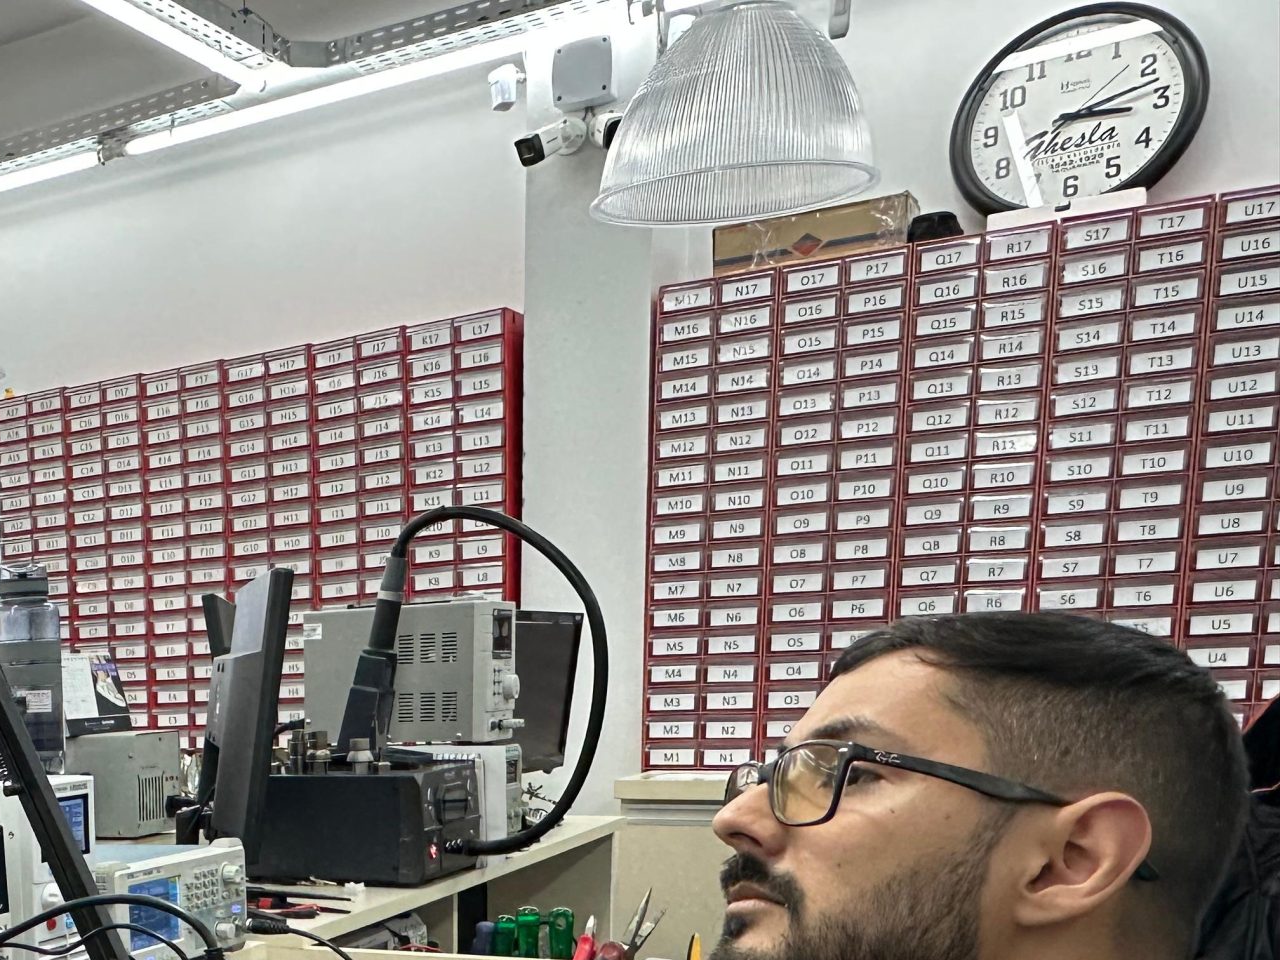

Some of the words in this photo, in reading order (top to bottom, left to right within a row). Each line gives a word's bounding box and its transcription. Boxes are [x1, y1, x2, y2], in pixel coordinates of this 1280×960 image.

[1141, 54, 1157, 78] 2
[1000, 86, 1027, 111] 10
[1153, 85, 1171, 110] 3
[983, 126, 999, 148] 9
[1135, 127, 1152, 148] 4
[995, 158, 1010, 180] 8
[1105, 156, 1121, 179] 5
[1063, 175, 1079, 197] 6
[1245, 202, 1276, 216] U17
[1158, 215, 1185, 229] T17
[1084, 227, 1110, 241] S17
[1241, 237, 1270, 252] U16
[936, 251, 961, 265] Q17
[1158, 250, 1184, 264] T16
[866, 262, 888, 276] P17
[1082, 262, 1106, 276] S16
[801, 273, 824, 286] O17
[1002, 274, 1027, 288] R16
[736, 284, 758, 296] N17
[1153, 285, 1179, 300] T15
[864, 294, 886, 307] P16
[798, 304, 822, 317] O16
[1235, 310, 1264, 324] U14
[675, 324, 698, 336] M16
[1150, 321, 1176, 334] T14
[798, 337, 821, 348] O15
[929, 350, 954, 362] Q14
[1232, 345, 1260, 358] U13
[861, 358, 882, 370] P14
[1148, 355, 1173, 368] T13
[731, 375, 754, 386] N14
[998, 374, 1021, 386] R13
[1228, 379, 1257, 393] U12
[928, 382, 952, 394] Q13
[1146, 386, 1172, 401] T12
[1072, 397, 1096, 409] S12
[672, 413, 696, 424] M13
[926, 414, 951, 426] Q12
[1226, 414, 1254, 426] U11
[857, 422, 878, 433] P12
[1144, 423, 1168, 436] T11
[794, 428, 817, 440] O12
[670, 441, 694, 452] M12
[730, 435, 751, 446] N12
[925, 445, 949, 457] Q11
[1224, 447, 1253, 462] U10
[856, 453, 876, 464] P11
[1140, 457, 1166, 469] T10
[728, 466, 749, 476] N11
[791, 460, 812, 470] O11
[1068, 464, 1092, 476] S10
[668, 470, 692, 482] M11
[989, 471, 1014, 484] R10
[854, 484, 875, 495] P10
[923, 478, 948, 489] Q10
[790, 490, 814, 500] O10
[1225, 484, 1244, 496] U9
[728, 495, 750, 506] N10
[1142, 492, 1158, 503] T9
[668, 498, 692, 510] M10
[994, 504, 1009, 514] R9
[1069, 499, 1084, 510] S9
[856, 515, 870, 525] P9
[924, 509, 941, 520] Q9
[730, 524, 744, 534] N9
[794, 518, 809, 528] O9
[1221, 518, 1240, 529] U8
[669, 530, 685, 539] M9
[1065, 530, 1082, 541] S8
[1140, 525, 1156, 536] T8
[990, 536, 1005, 546] R8
[854, 544, 868, 555] P8
[728, 553, 742, 563] N8
[1218, 552, 1238, 564] U7
[988, 564, 1004, 577] R7
[1062, 562, 1078, 572] S7
[852, 575, 866, 585] P7
[920, 570, 937, 582] Q7
[668, 584, 685, 595] M7
[727, 583, 741, 592] N7
[790, 579, 805, 588] O7
[1136, 591, 1151, 602] T6
[1215, 584, 1234, 597] U6
[987, 597, 1002, 608] R6
[1060, 593, 1075, 605] S6
[851, 604, 864, 614] P6
[918, 600, 935, 612] Q6
[668, 612, 685, 622] M6
[1212, 619, 1230, 630] U5
[1208, 652, 1226, 663] U4
[786, 666, 801, 676] O4
[723, 696, 736, 706] N3
[784, 695, 799, 704] O3
[664, 752, 679, 762] M1
[720, 753, 733, 762] N1
